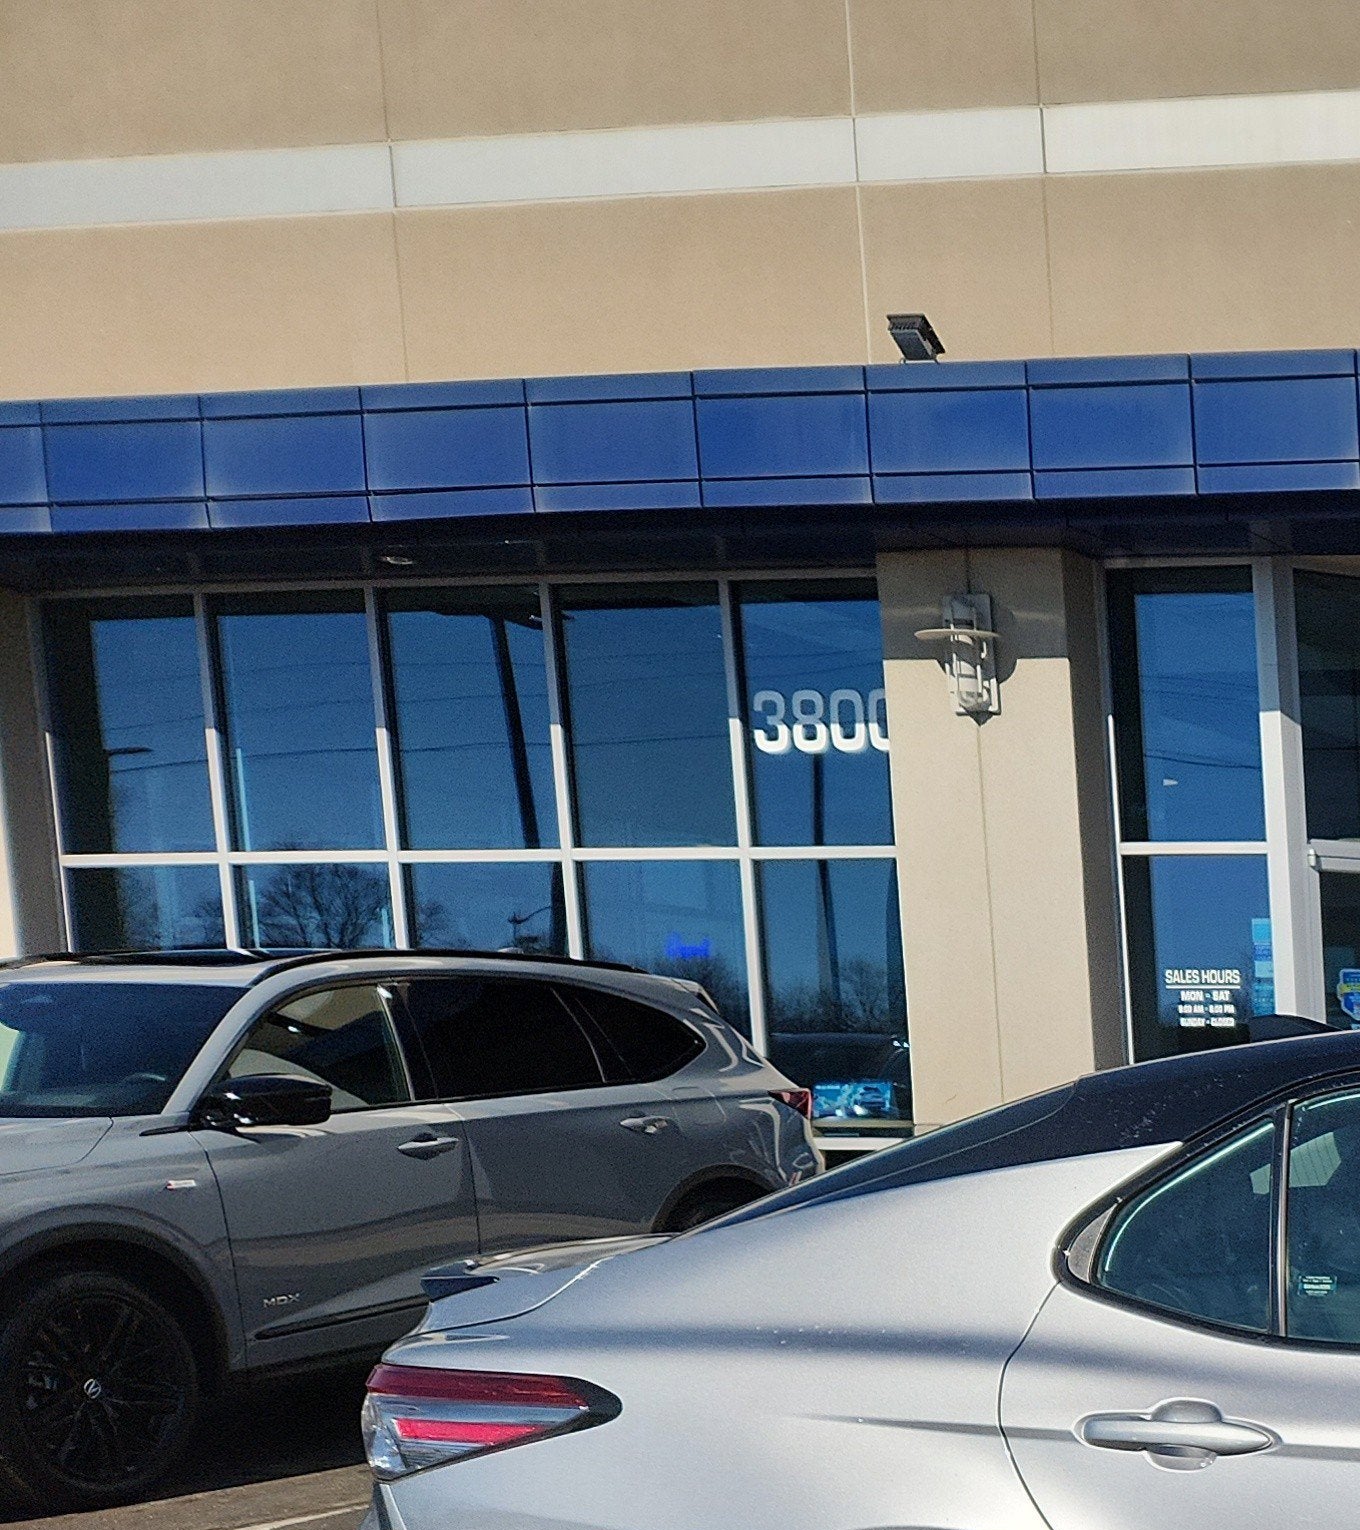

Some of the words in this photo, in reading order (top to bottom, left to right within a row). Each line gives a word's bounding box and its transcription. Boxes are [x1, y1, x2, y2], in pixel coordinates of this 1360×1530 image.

[753, 688, 890, 753] 3800
[1165, 969, 1200, 984] SALES
[1201, 969, 1241, 984] HOURS
[1180, 990, 1204, 1002] MON
[1212, 990, 1231, 1001] SAT
[262, 1292, 300, 1308] MDX
